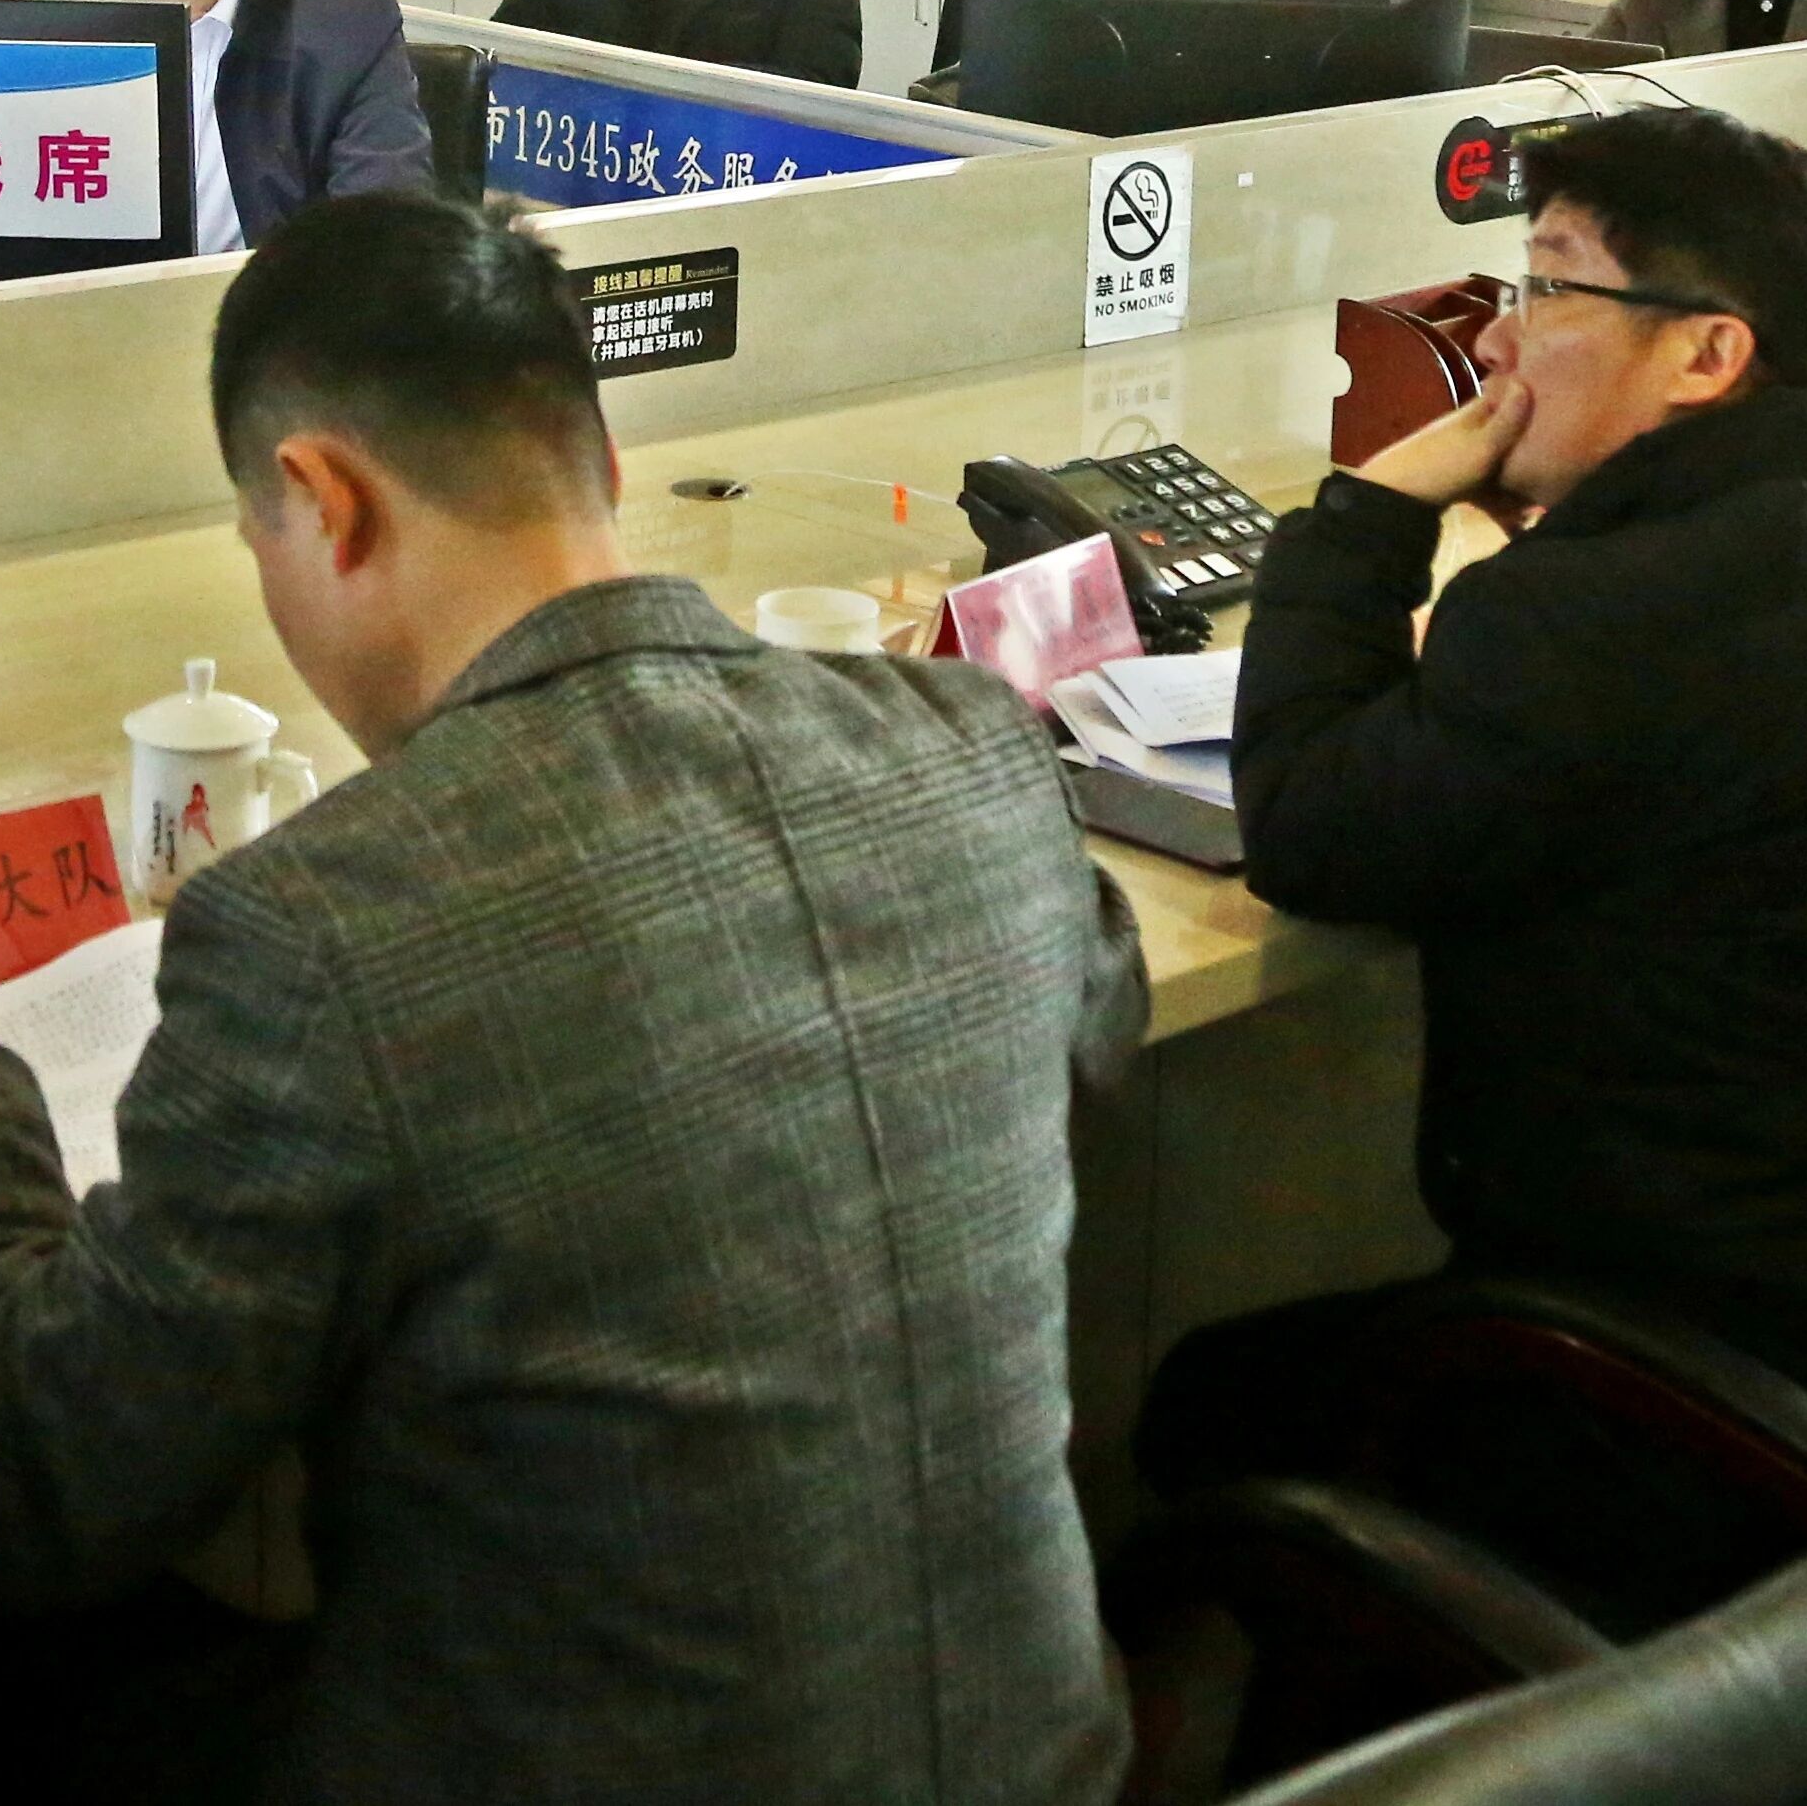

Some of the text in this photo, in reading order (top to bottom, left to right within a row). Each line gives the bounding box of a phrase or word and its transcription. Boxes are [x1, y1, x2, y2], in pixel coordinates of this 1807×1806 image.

[1095, 263, 1175, 297] 禁止吸烟
[593, 290, 713, 325] 请您在话机屏幕亮时
[1095, 292, 1175, 317] NO SMOKING
[1127, 452, 1189, 475] 1 2 3
[1154, 472, 1218, 497] 4 5 6
[1178, 494, 1247, 520] 7 8 9
[1230, 520, 1254, 535] 0
